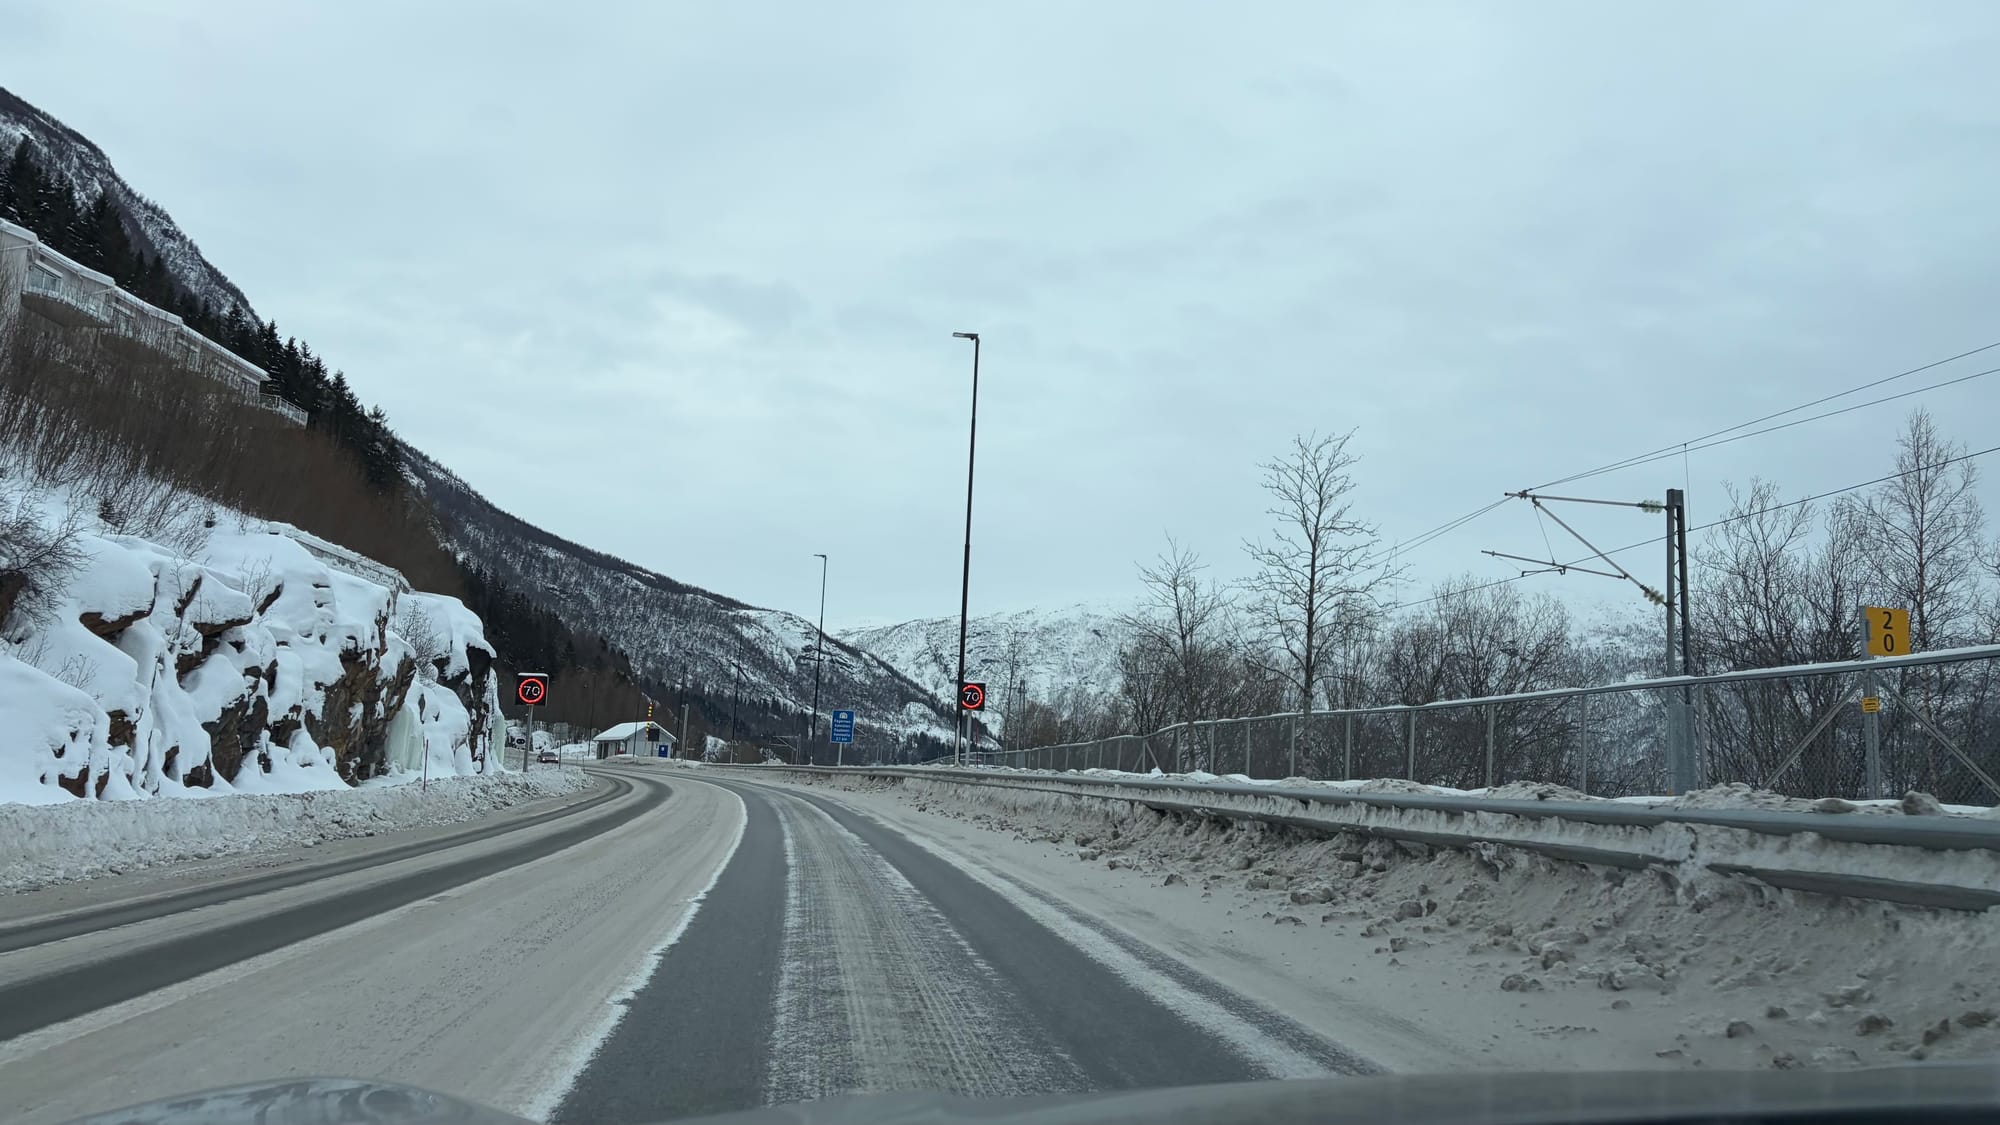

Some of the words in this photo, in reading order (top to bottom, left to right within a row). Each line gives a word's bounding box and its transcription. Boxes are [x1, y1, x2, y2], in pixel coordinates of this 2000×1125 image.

[1882, 611, 1893, 630] 2
[1883, 633, 1894, 652] 0
[523, 685, 540, 696] 70
[964, 691, 980, 702] 70
